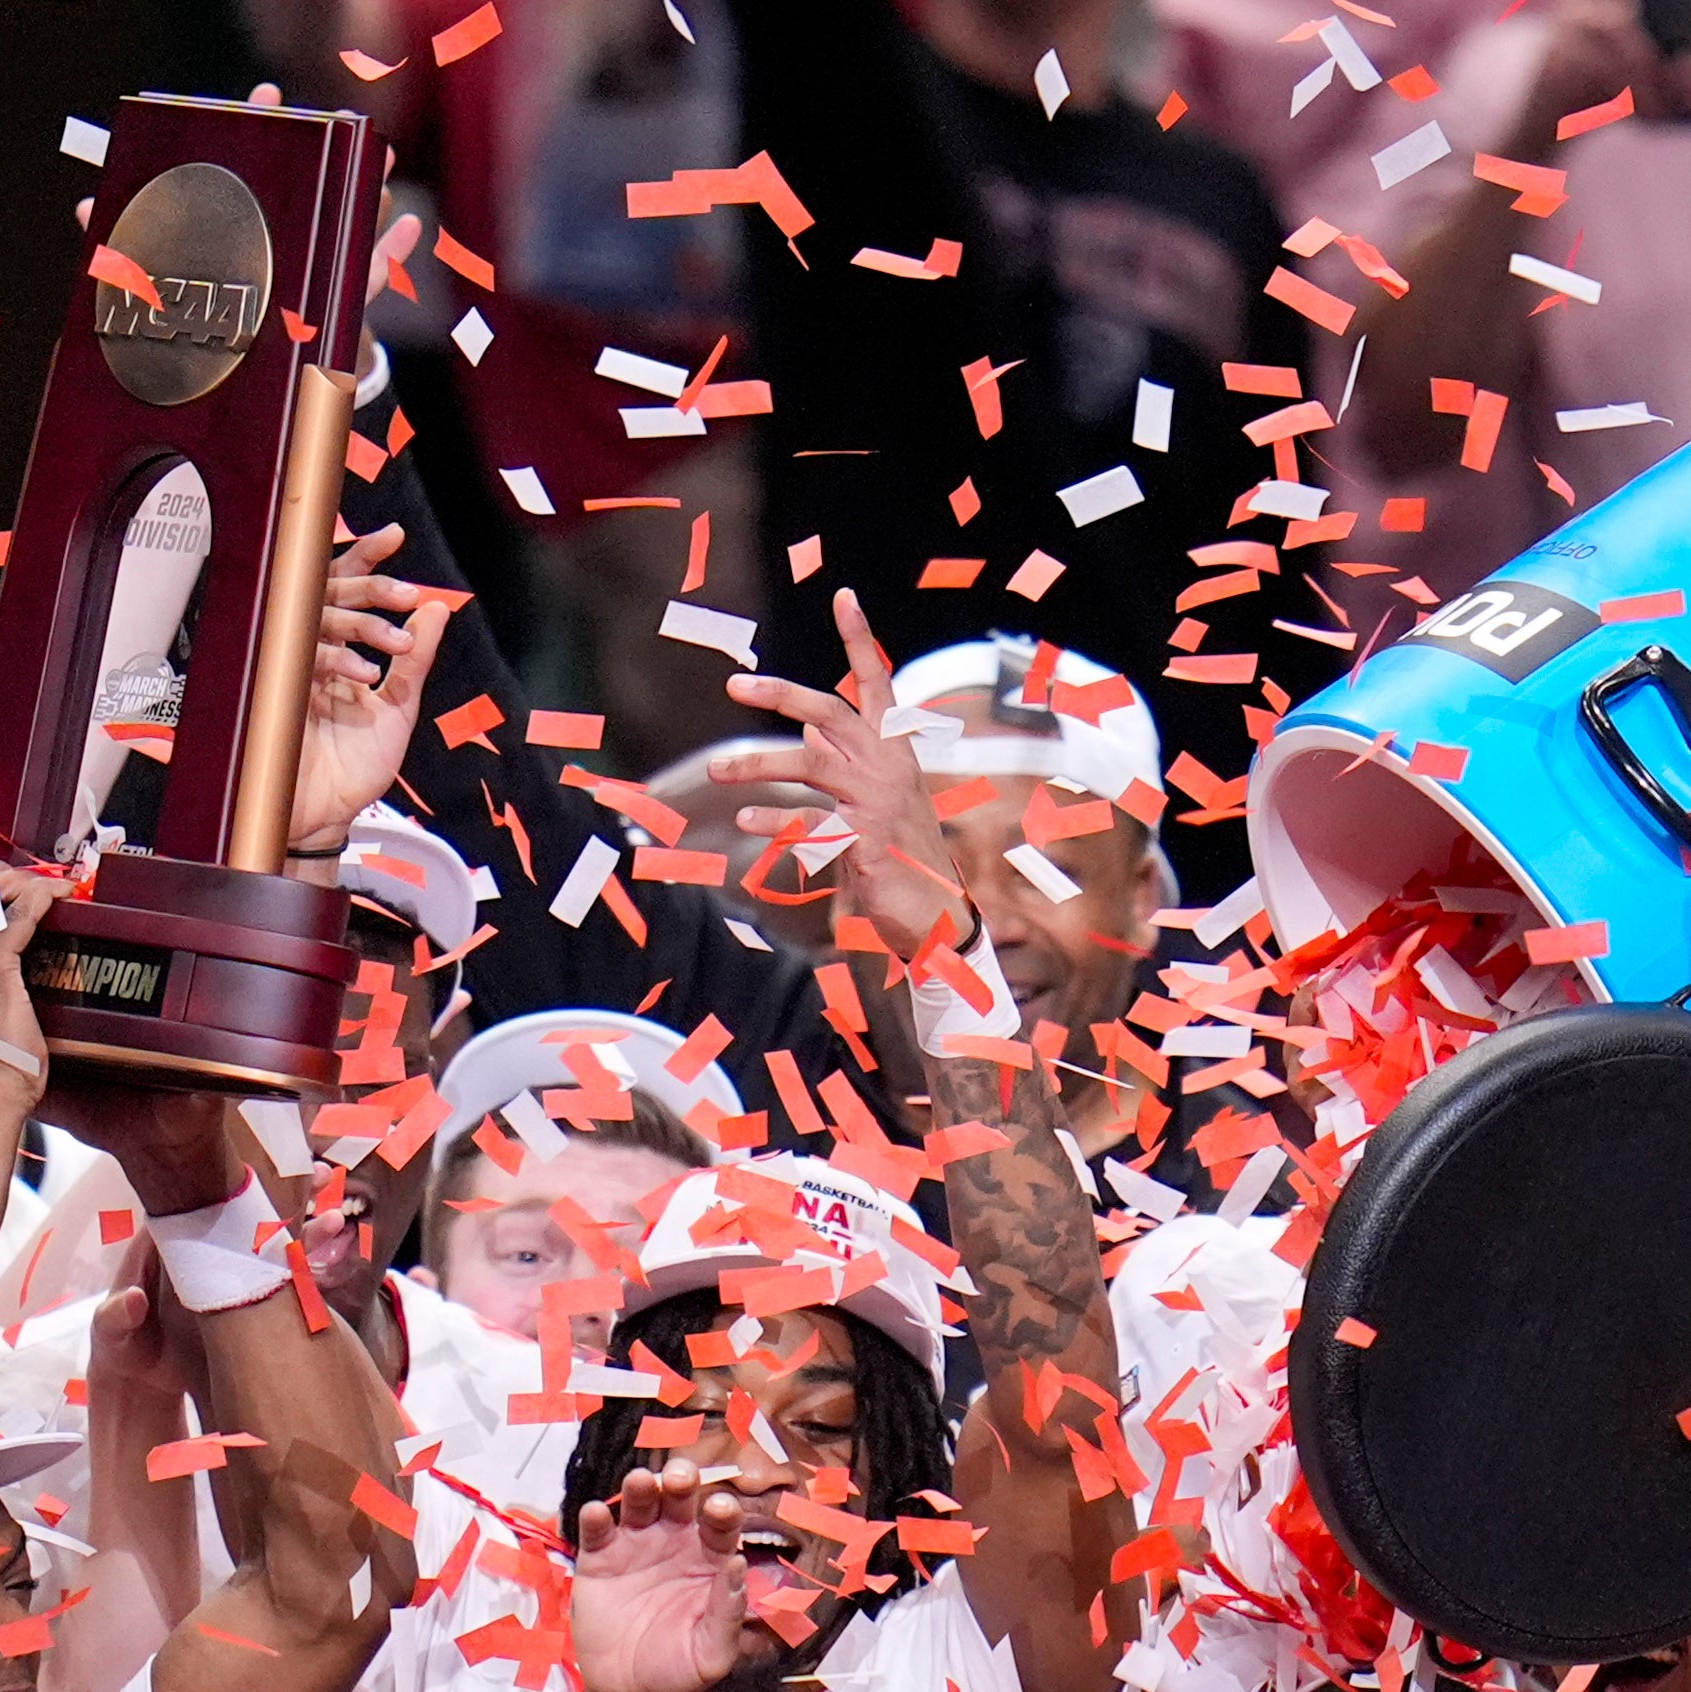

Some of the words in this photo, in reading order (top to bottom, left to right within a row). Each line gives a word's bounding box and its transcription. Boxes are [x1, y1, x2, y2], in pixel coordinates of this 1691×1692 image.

[156, 492, 205, 519] 2024
[1397, 590, 1564, 658] PO
[119, 672, 169, 698] MARCH
[29, 950, 162, 1002] CHAMPION
